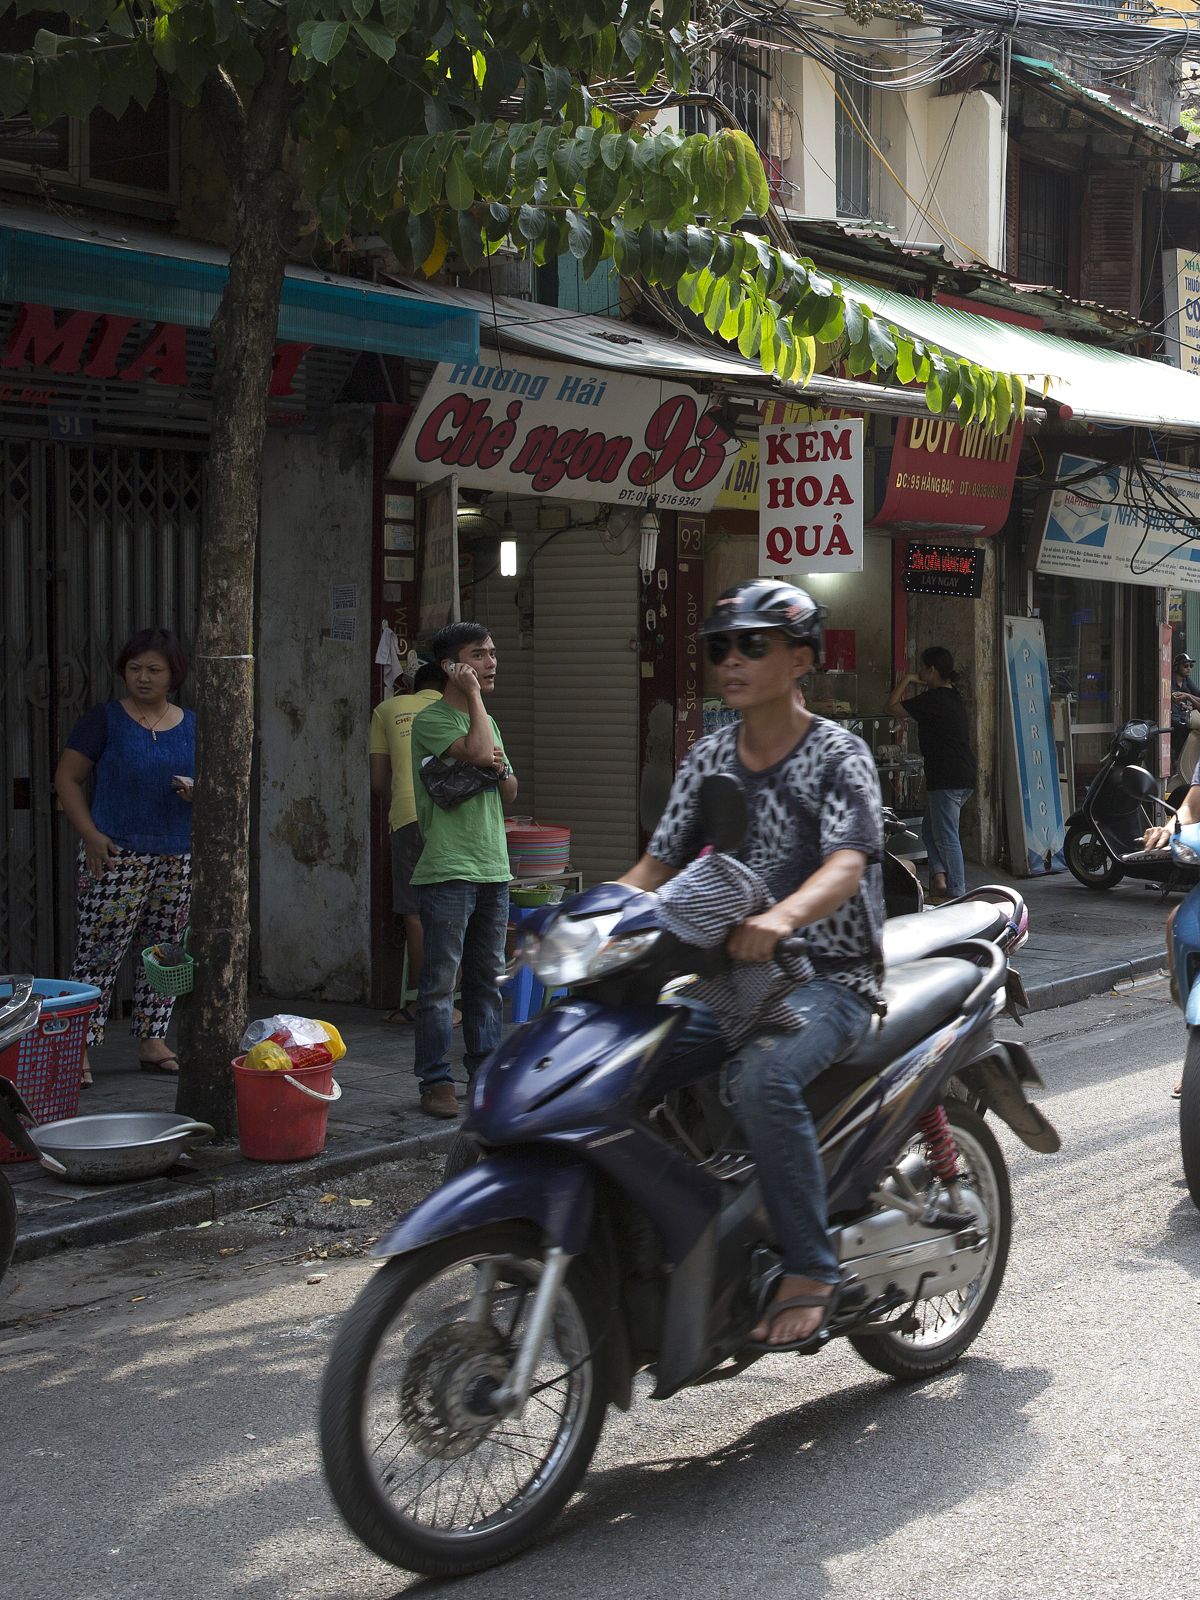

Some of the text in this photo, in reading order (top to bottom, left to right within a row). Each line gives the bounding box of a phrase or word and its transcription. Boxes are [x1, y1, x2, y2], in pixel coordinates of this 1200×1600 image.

[556, 374, 609, 408] Hải
[58, 415, 83, 436] 91
[510, 424, 633, 492] ngon
[628, 394, 727, 492] 93
[909, 417, 956, 455] DUY
[766, 428, 853, 466] KEM
[618, 488, 635, 501] ĐT:
[660, 493, 679, 506] 516
[678, 495, 702, 508] 9347
[767, 473, 855, 509] HOA
[911, 475, 921, 490] 95
[921, 471, 941, 494] HÀNG
[941, 479, 955, 498] BẠC
[681, 528, 701, 551] 93
[766, 512, 854, 565] QUẢ
[937, 576, 959, 589] NGAY
[394, 607, 408, 656] GEM
[1022, 648, 1050, 842] PHARMACY
